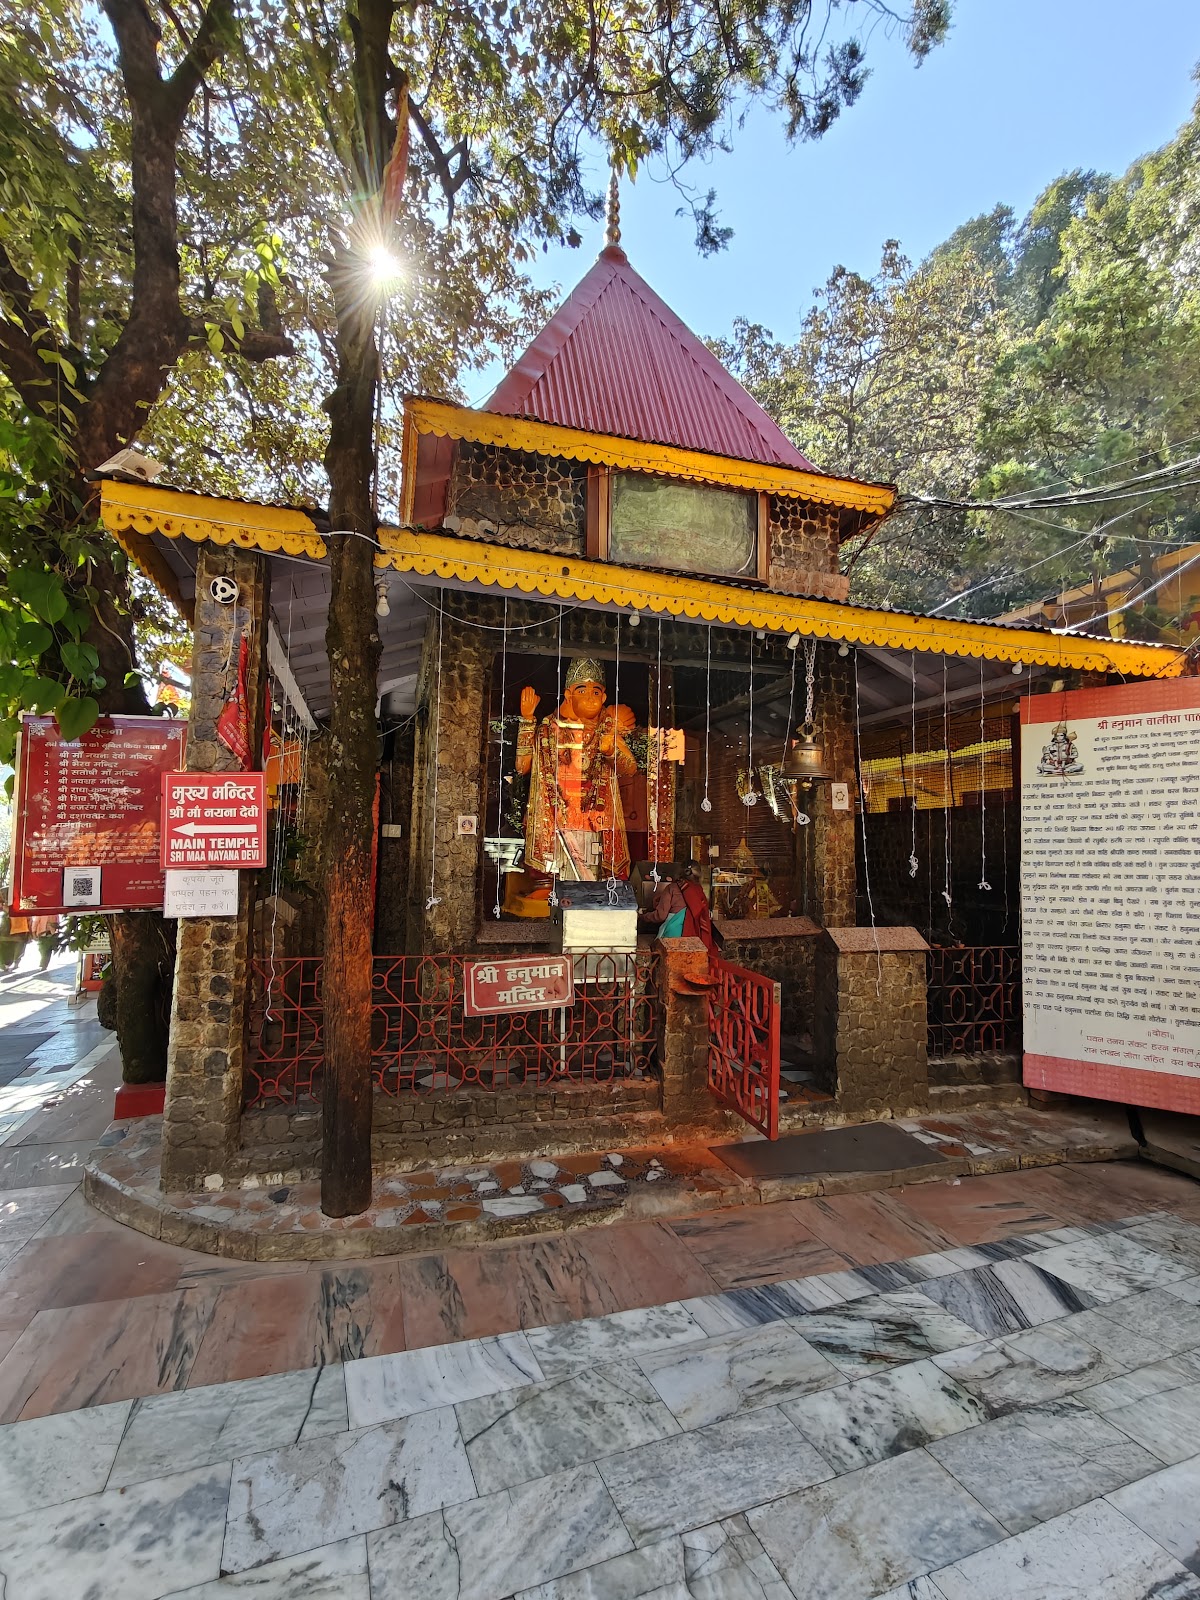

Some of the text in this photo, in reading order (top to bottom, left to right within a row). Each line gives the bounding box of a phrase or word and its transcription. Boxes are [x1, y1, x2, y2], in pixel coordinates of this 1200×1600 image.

[1097, 719, 1108, 729] श्री
[1110, 718, 1143, 730] हनुमान
[1146, 713, 1181, 725] चालीसा
[129, 752, 153, 760] मन्दिर
[94, 760, 119, 768] मन्दिर
[100, 777, 125, 785] मन्दिर
[58, 785, 67, 793] श्री
[172, 782, 256, 804] मुख्य मन्दिर
[169, 805, 185, 818] श्री
[204, 808, 237, 818] नयना
[240, 805, 259, 818] देवी
[170, 839, 205, 850] MAIN
[209, 838, 259, 848] TEMPLE
[170, 850, 259, 862] SRI MAA NAYANA DEVI
[182, 874, 224, 886] कृपया जूते
[176, 902, 195, 911] प्रवेश
[476, 964, 564, 984] श्री हनुमान
[496, 986, 546, 1004] मन्दिर
[1086, 1035, 1104, 1043] पवन
[1106, 1037, 1124, 1045] तनय
[1151, 1043, 1168, 1051] हरन
[1099, 1048, 1120, 1057] लखन
[1122, 1051, 1140, 1059] सीता
